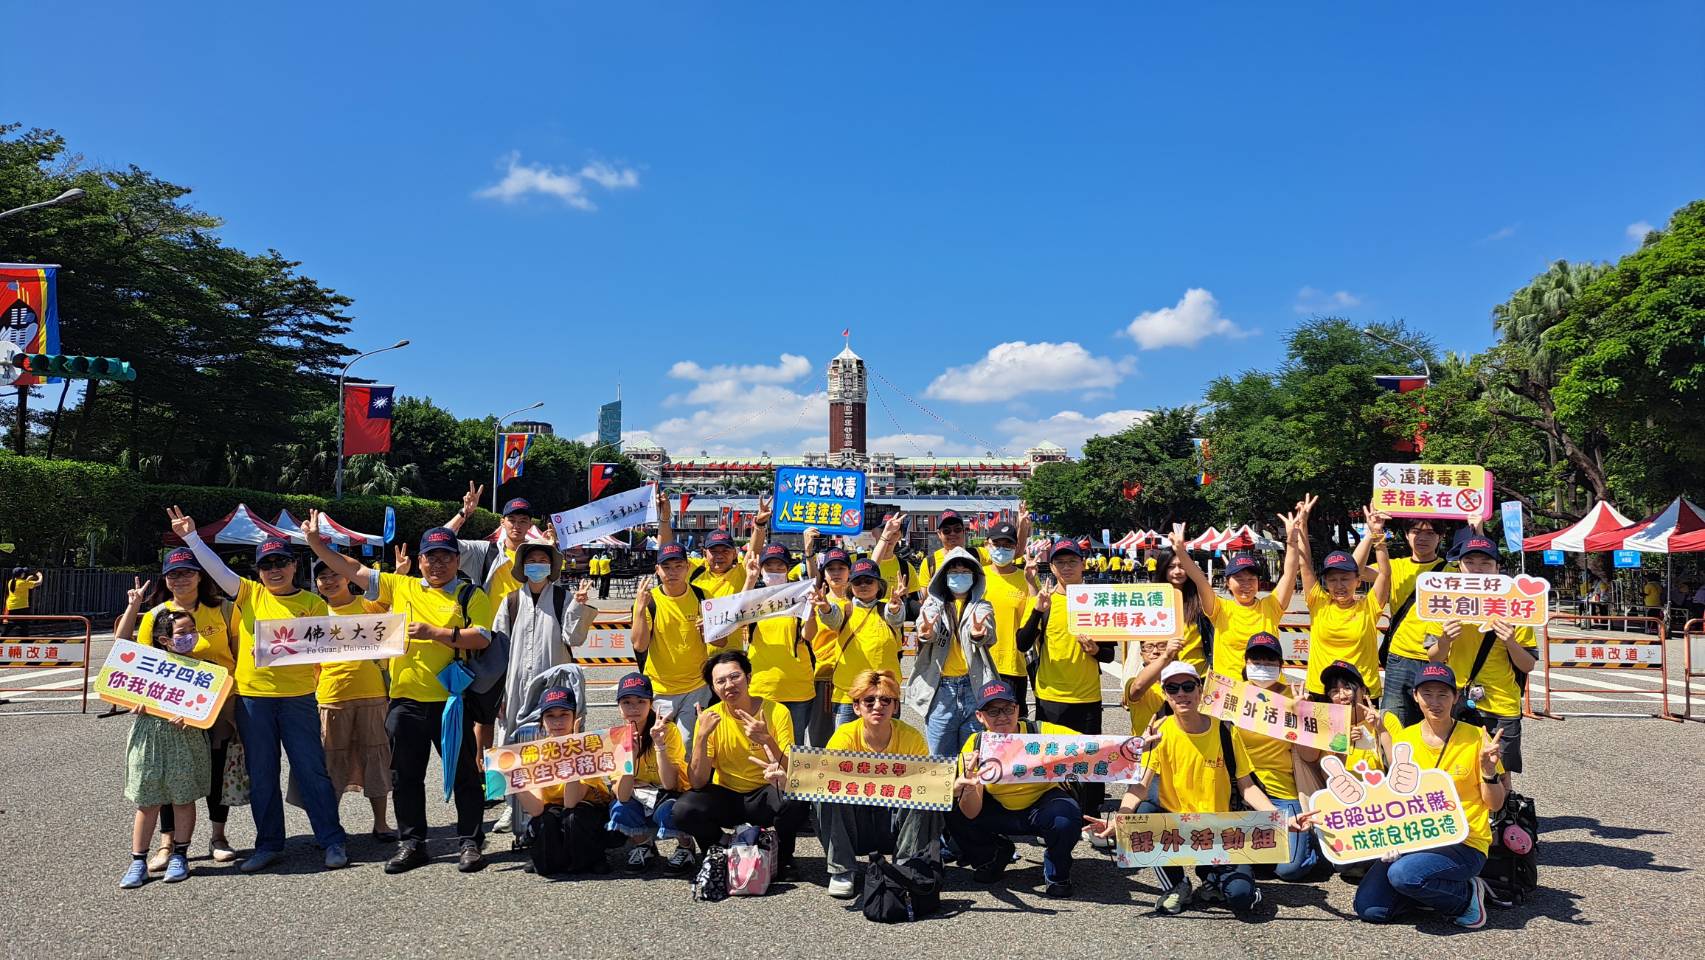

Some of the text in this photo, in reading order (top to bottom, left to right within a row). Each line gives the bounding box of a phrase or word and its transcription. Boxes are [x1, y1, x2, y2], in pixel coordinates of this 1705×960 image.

[793, 473, 857, 498] 好奇去吸毒
[1400, 468, 1472, 487] 遠離毒害
[1381, 489, 1453, 508] 幸福永在
[779, 501, 843, 526] 人生塗塗塗
[1425, 576, 1502, 592] 心存三好
[1093, 591, 1164, 607] 深耕品德
[1428, 594, 1536, 619] 共創美好
[1077, 612, 1146, 627] 三好傳承
[0, 646, 58, 659] 輛改道
[343, 644, 380, 653] University
[1293, 639, 1309, 654] 禁
[1574, 646, 1638, 661] 車輛改道
[136, 655, 215, 690] 三好四給
[107, 670, 186, 706] 你我做起
[1223, 692, 1319, 734] 課外活動組
[519, 734, 604, 766] 佛光大學
[1024, 741, 1100, 756] 佛光大學
[511, 752, 616, 789] 學生事務處
[838, 760, 907, 778] 佛光大學
[1012, 760, 1109, 778] 學生事務處
[827, 779, 913, 800] 學生事務處
[1324, 790, 1447, 830] 拒絕出口成髒
[1129, 827, 1277, 853] 課外活動組
[1352, 814, 1458, 851] 成就良好品德
